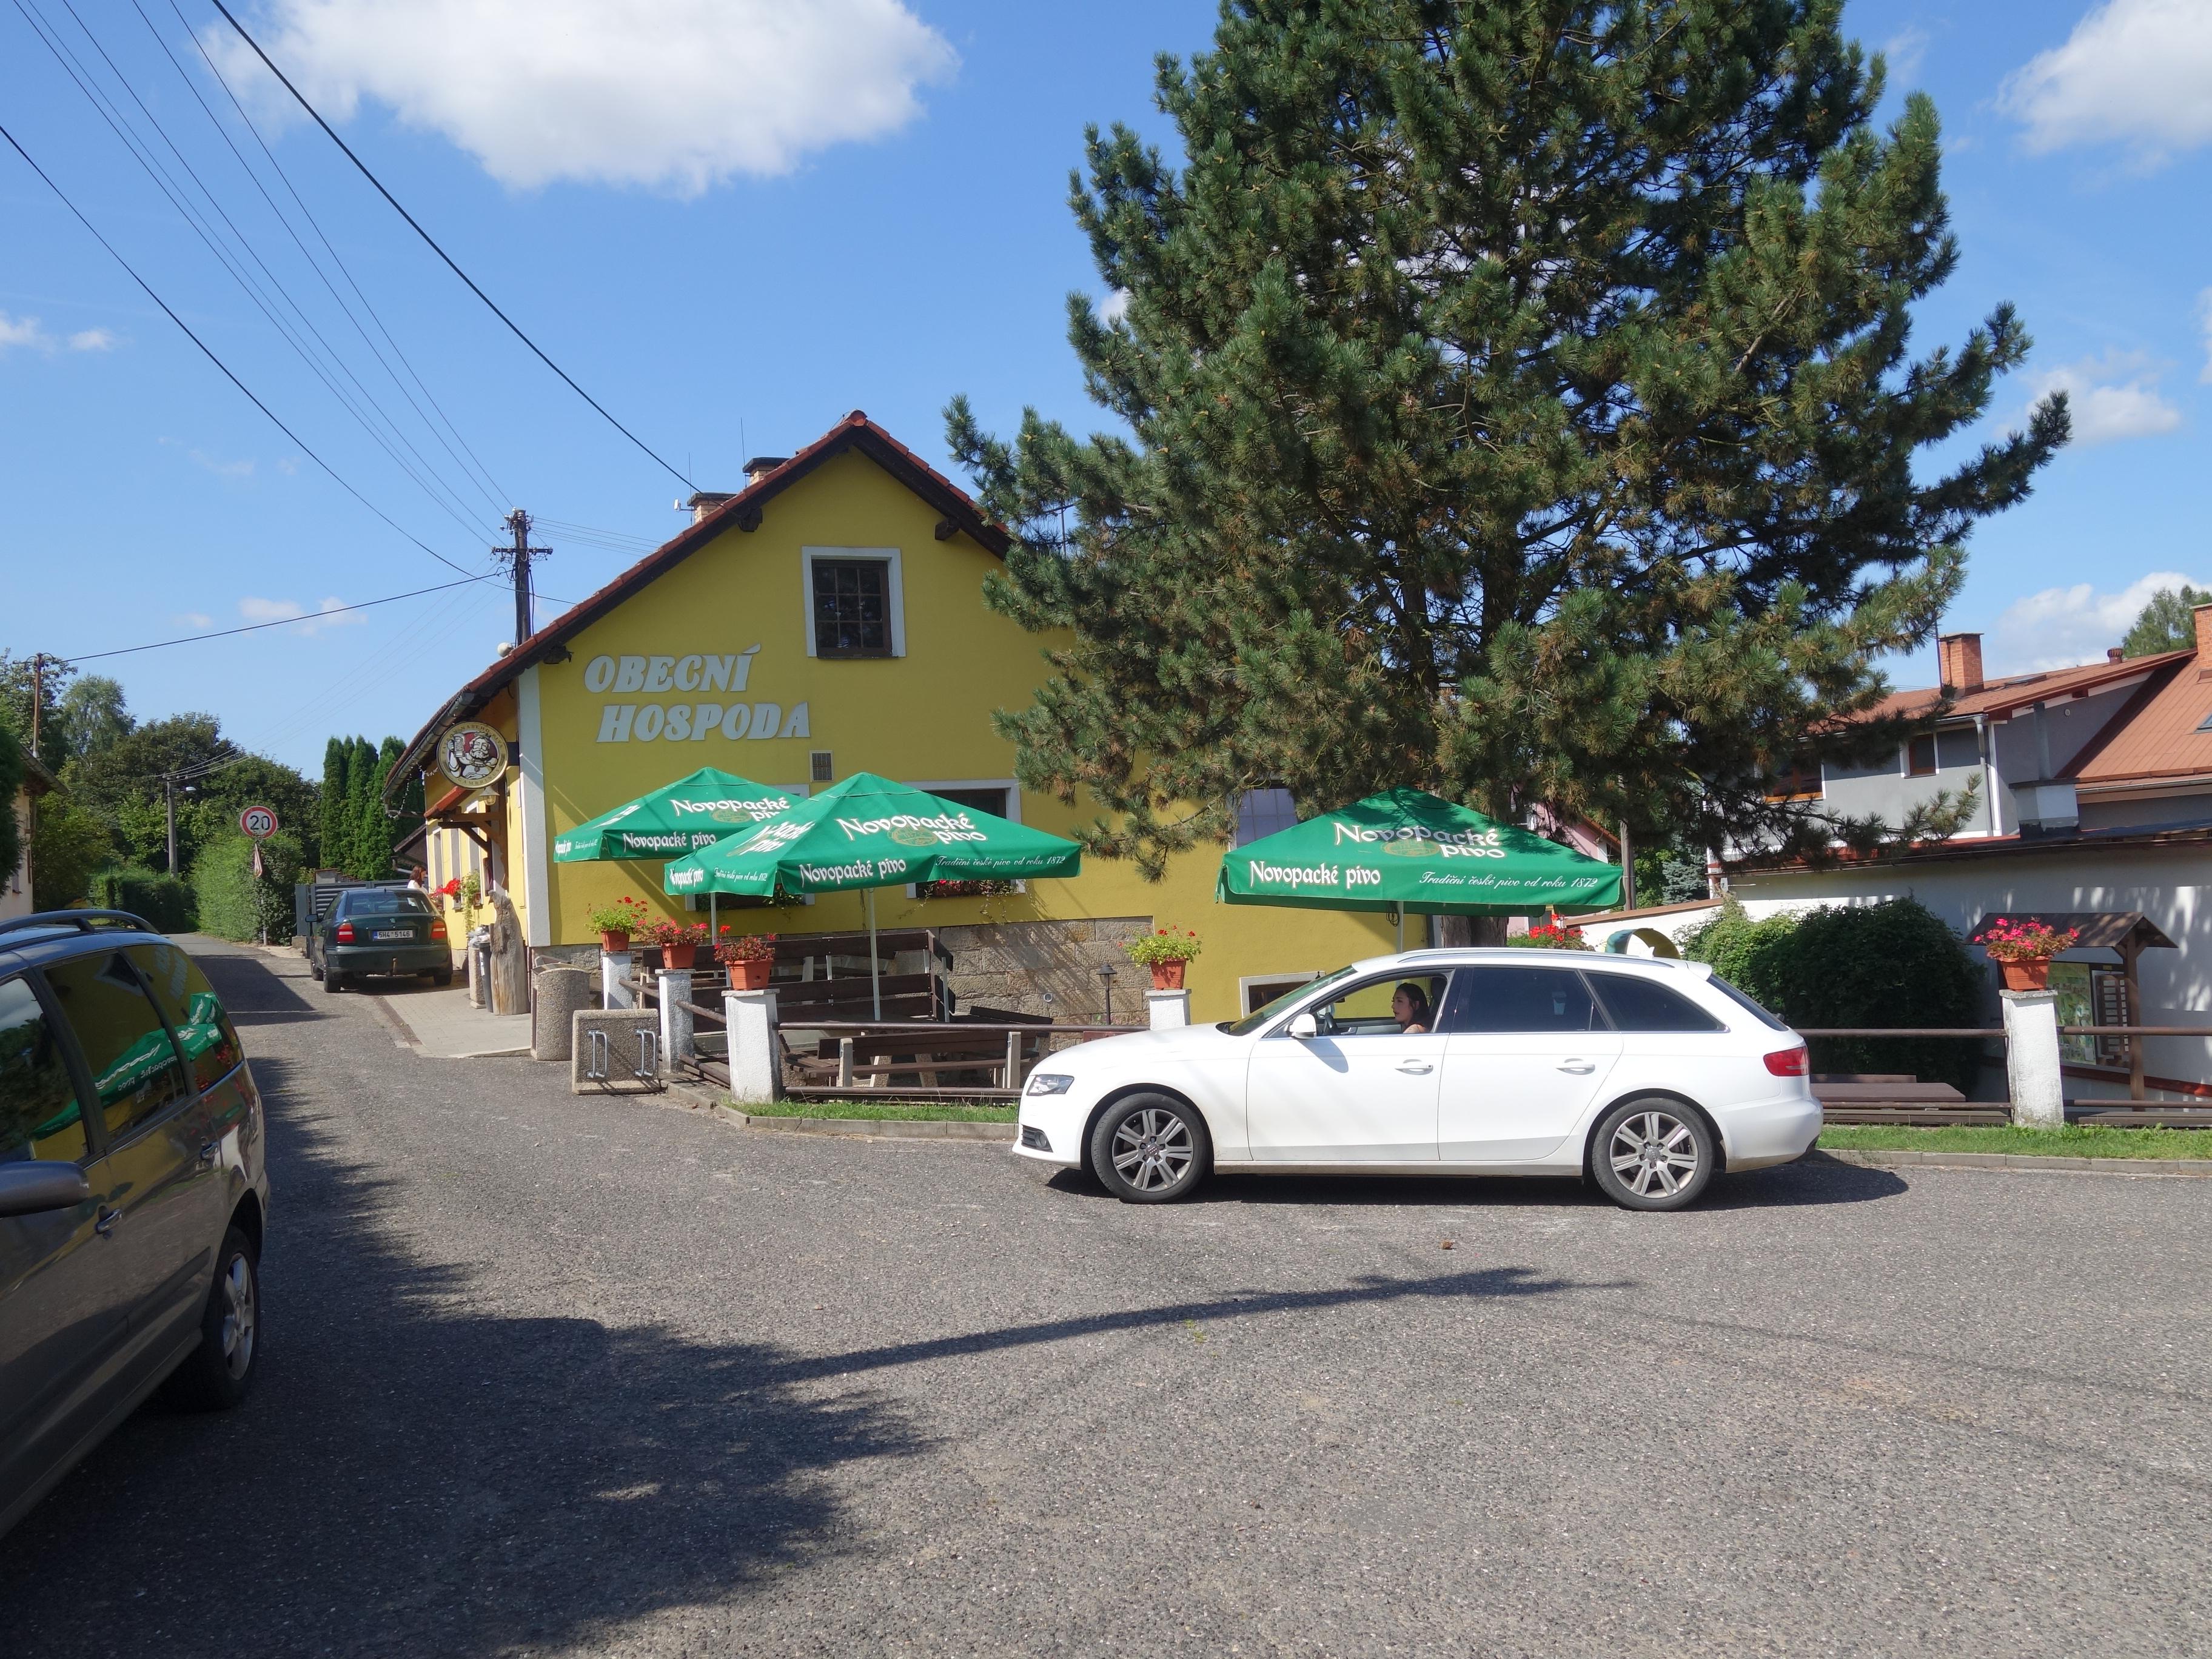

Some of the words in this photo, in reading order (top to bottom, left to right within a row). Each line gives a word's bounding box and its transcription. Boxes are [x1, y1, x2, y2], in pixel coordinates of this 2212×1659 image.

[584, 643, 761, 693] OBECNÍ
[596, 702, 811, 743] HOSPODA
[669, 797, 791, 817] Novopacké
[250, 815, 270, 830] 20
[836, 813, 974, 841] Novopacké
[622, 831, 687, 852] Novopacké
[692, 832, 716, 850] pivo
[933, 829, 987, 844] pivo
[1333, 822, 1501, 846] Novopacké
[973, 857, 993, 866] české
[993, 858, 1011, 868] pivo
[1014, 857, 1026, 865] od
[1026, 856, 1044, 865] roku
[1439, 845, 1506, 858] pivo
[799, 860, 873, 888] Novopacké
[878, 859, 907, 879] pivo
[1249, 860, 1339, 888] Novopacké
[1346, 865, 1381, 889] pivo
[1419, 871, 1466, 885] Tradiční
[1468, 874, 1495, 886] české
[1494, 876, 1521, 889] pivo
[1524, 876, 1543, 887] od
[1541, 876, 1567, 887] roku
[1570, 877, 1598, 887] 1872
